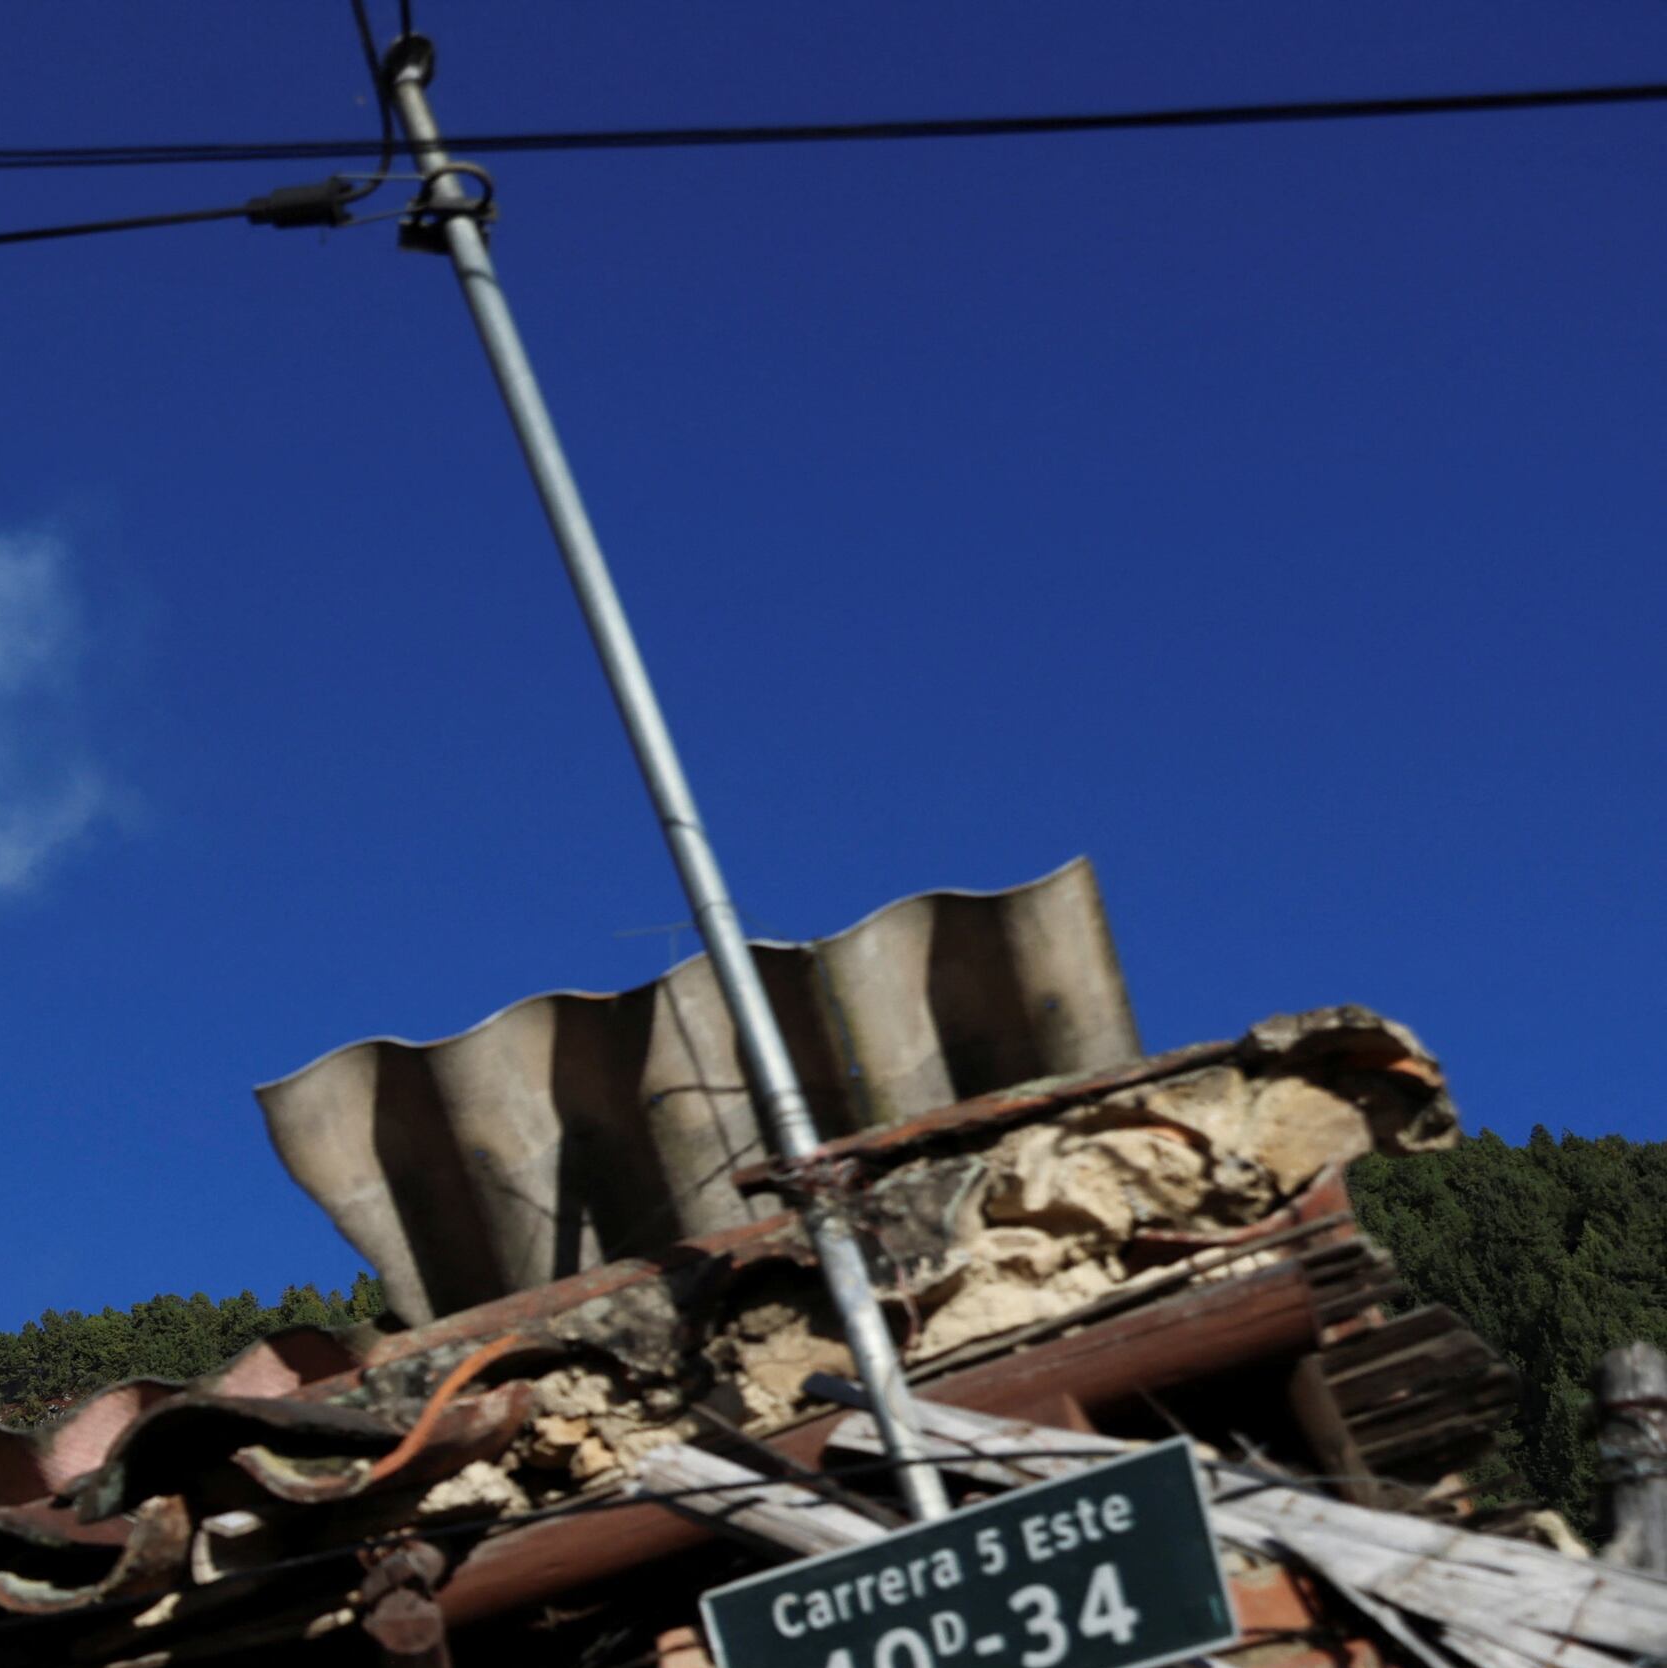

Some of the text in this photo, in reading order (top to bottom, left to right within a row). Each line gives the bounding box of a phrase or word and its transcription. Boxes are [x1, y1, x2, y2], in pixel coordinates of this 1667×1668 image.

[772, 1492, 1135, 1638] Carrera 5 Este
